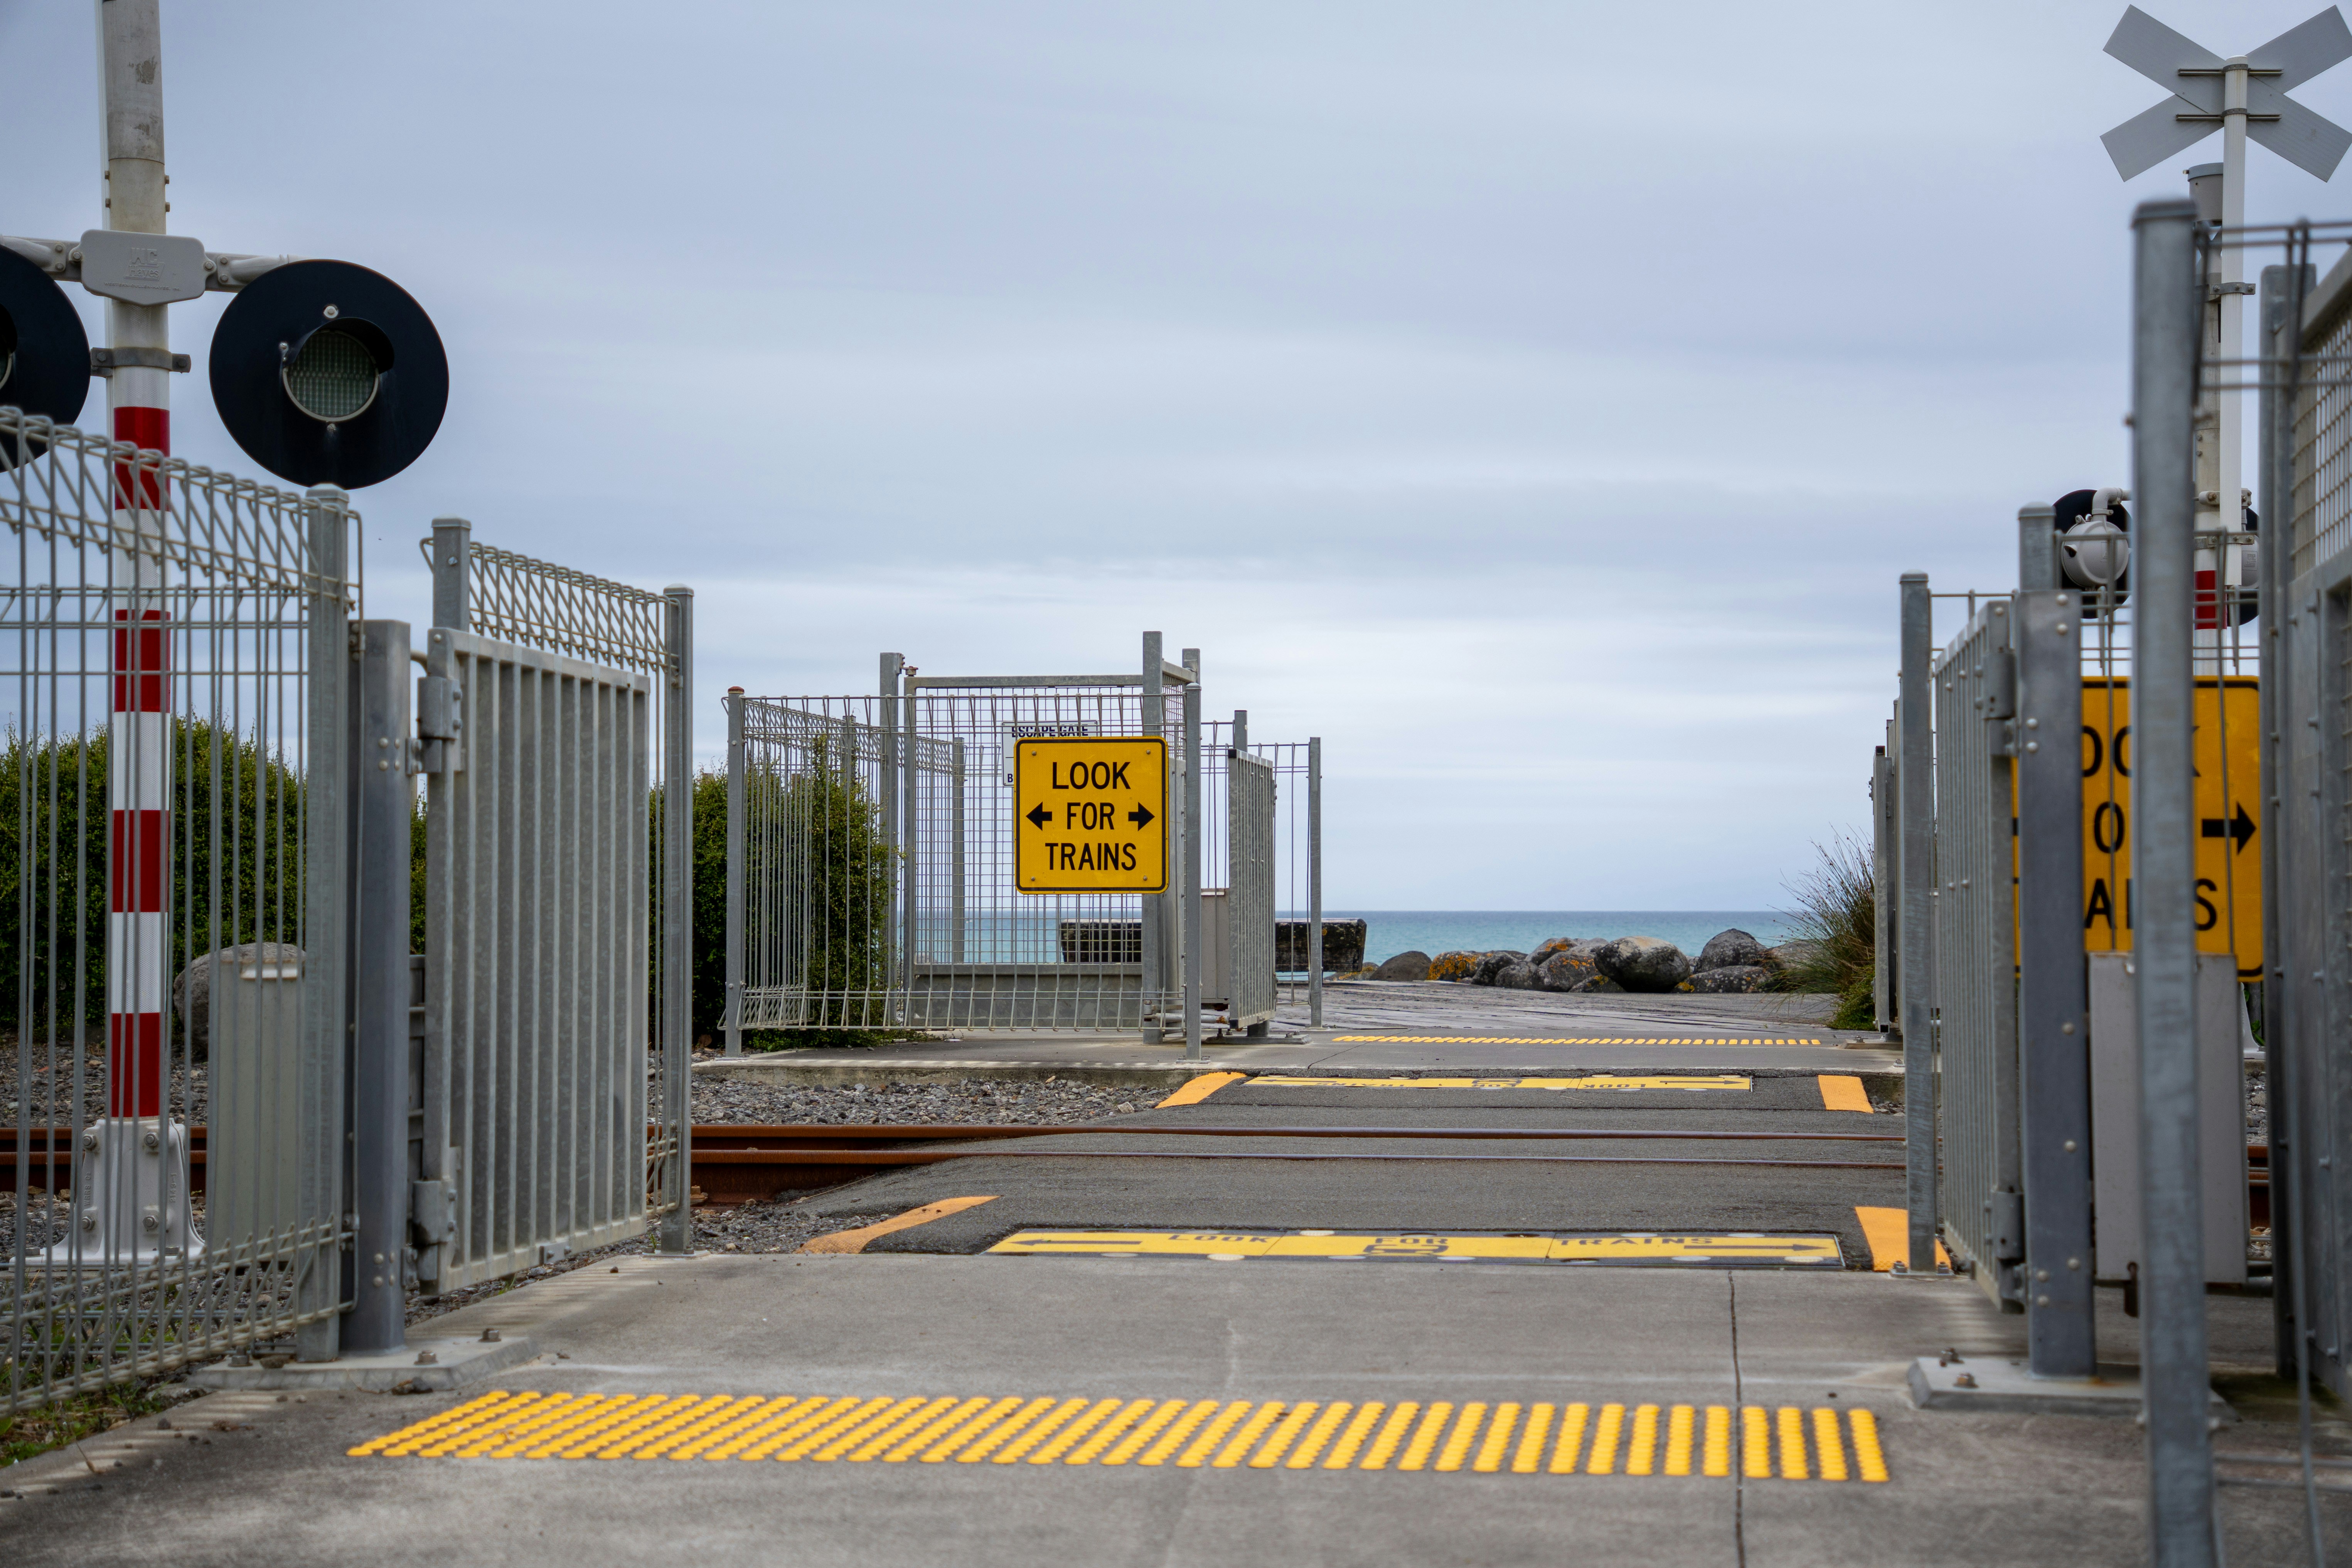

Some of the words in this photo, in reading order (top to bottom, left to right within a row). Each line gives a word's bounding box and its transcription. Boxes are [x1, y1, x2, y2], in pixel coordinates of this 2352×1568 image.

[128, 265, 159, 278] Hayes
[1053, 762, 1131, 790] LOOK
[1067, 802, 1115, 830] FOR
[1045, 843, 1137, 871] TRAINS
[1168, 1235, 1272, 1243] LOOK
